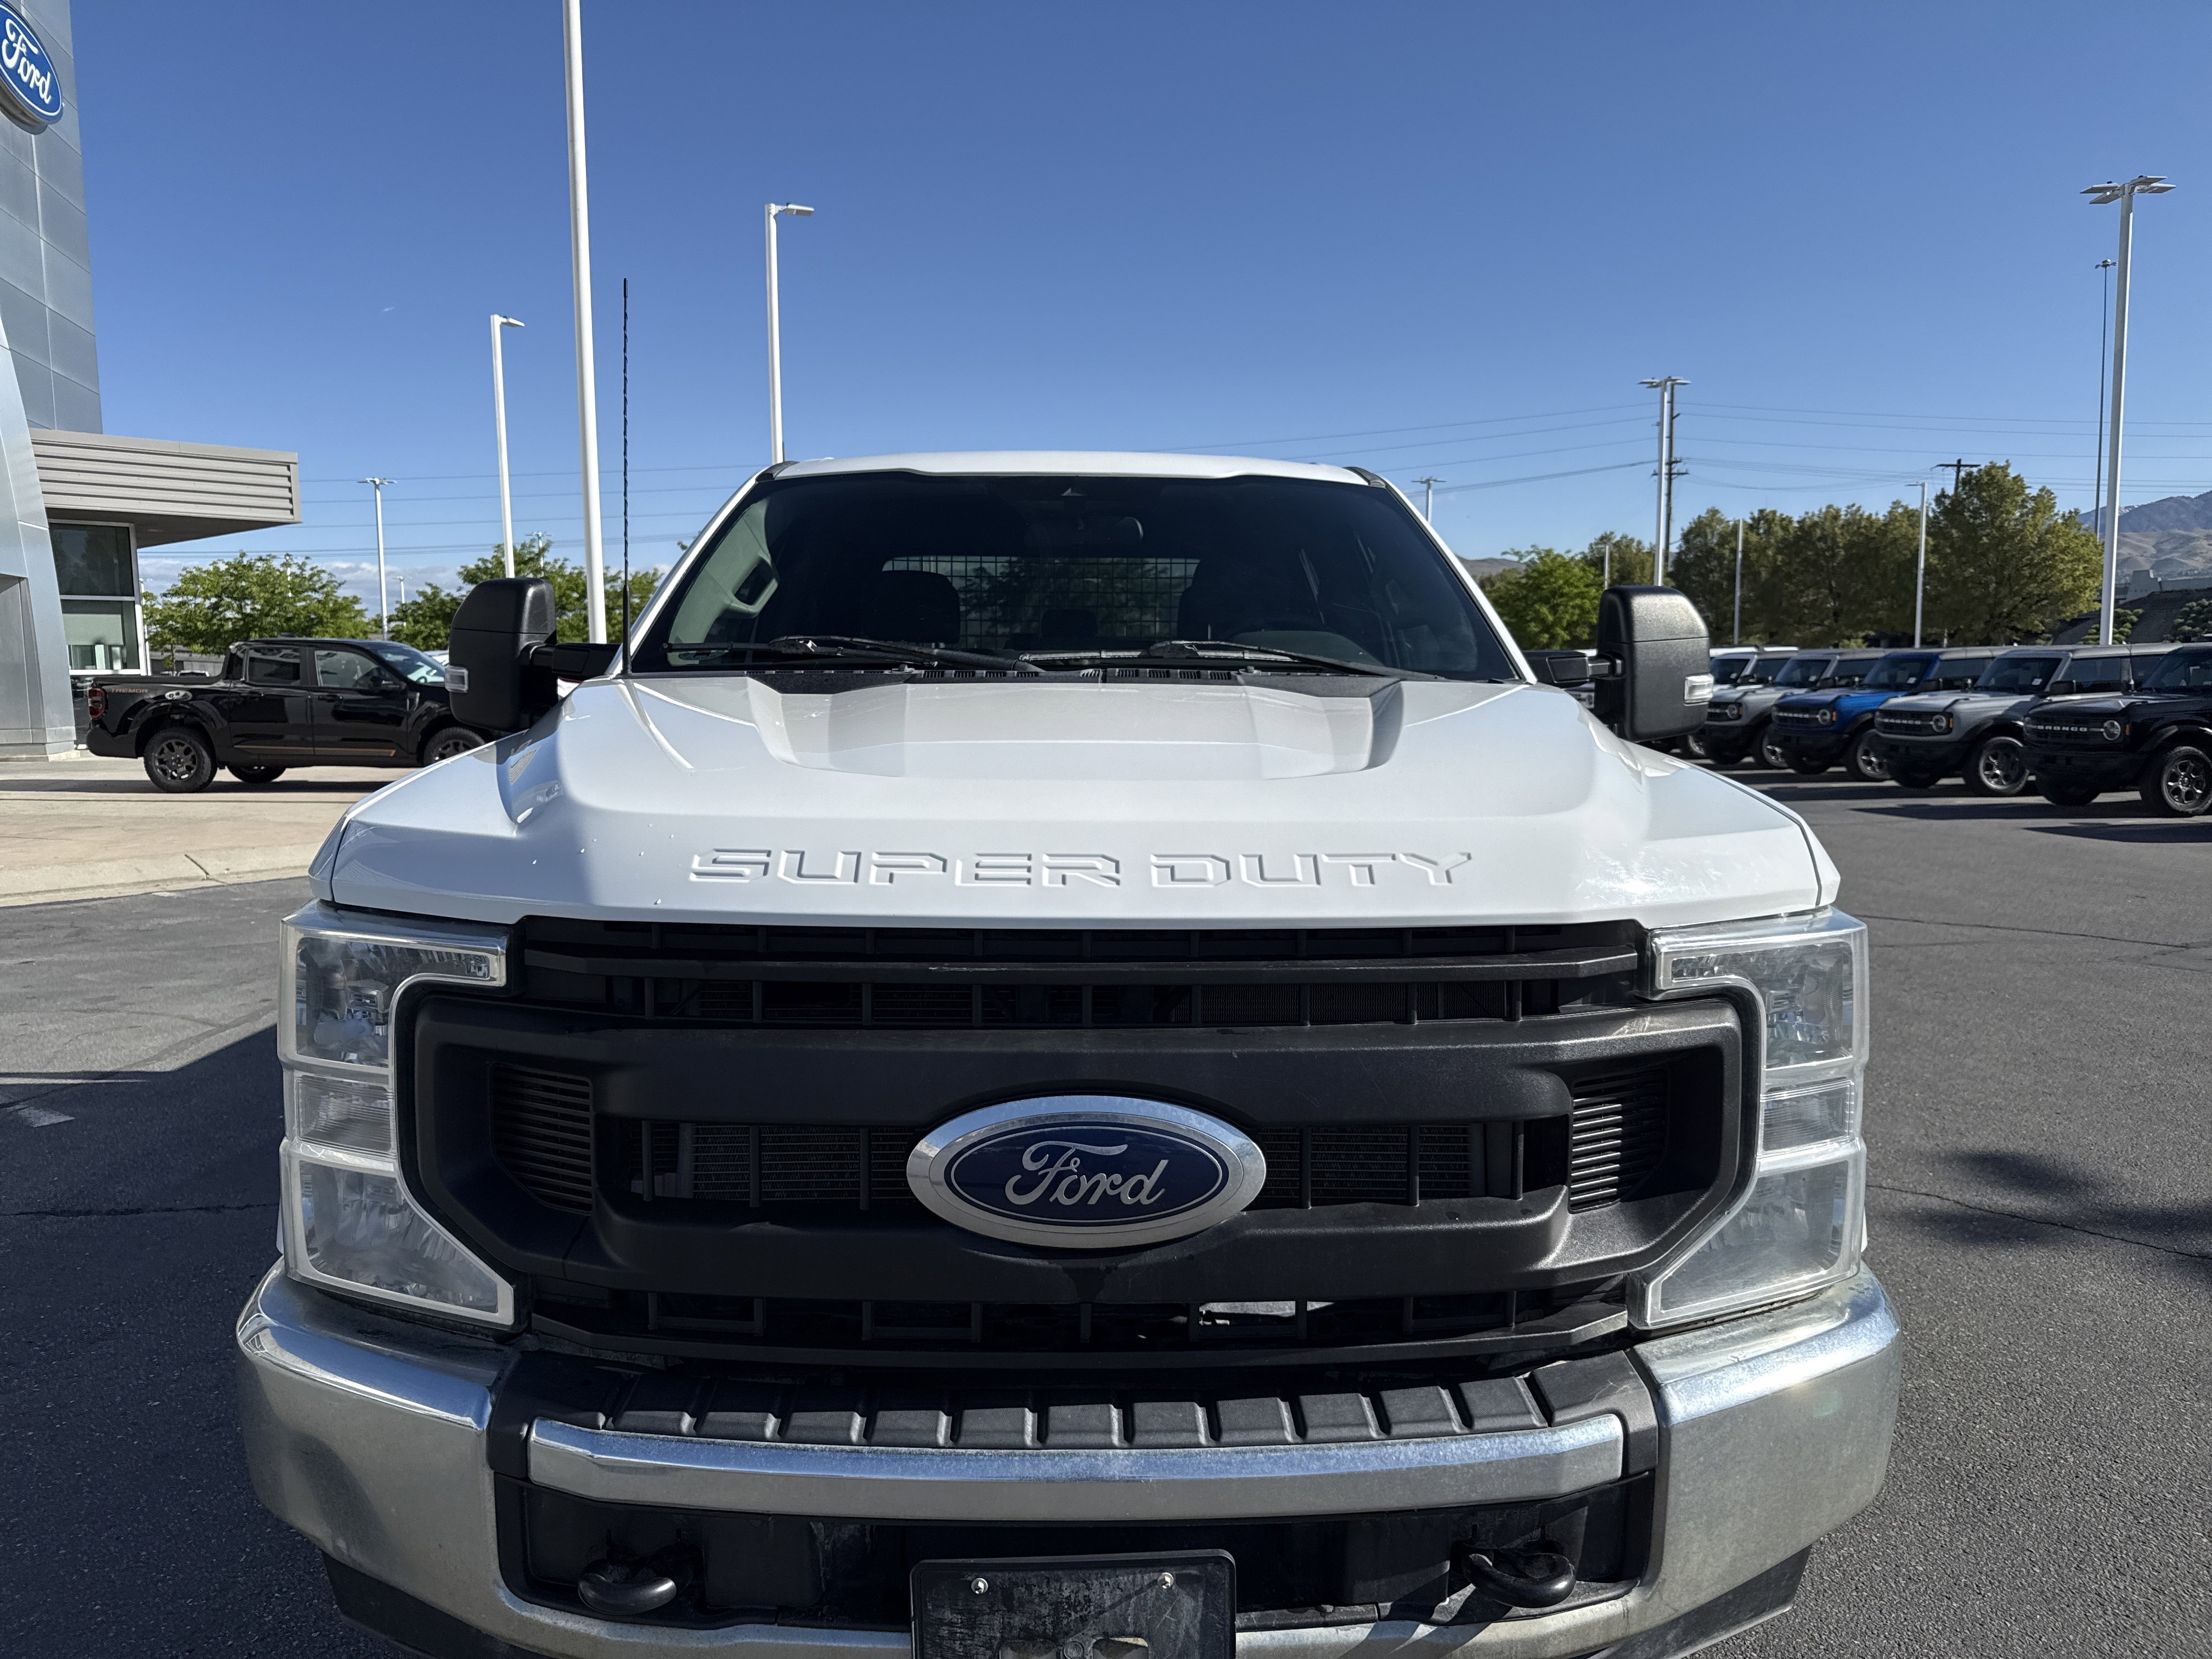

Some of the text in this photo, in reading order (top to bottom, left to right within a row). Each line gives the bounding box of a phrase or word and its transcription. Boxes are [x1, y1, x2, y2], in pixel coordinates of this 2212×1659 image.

[2, 18, 51, 104] Ford
[689, 848, 1472, 887] SUPER DUTY
[1005, 1140, 1169, 1205] Ford
